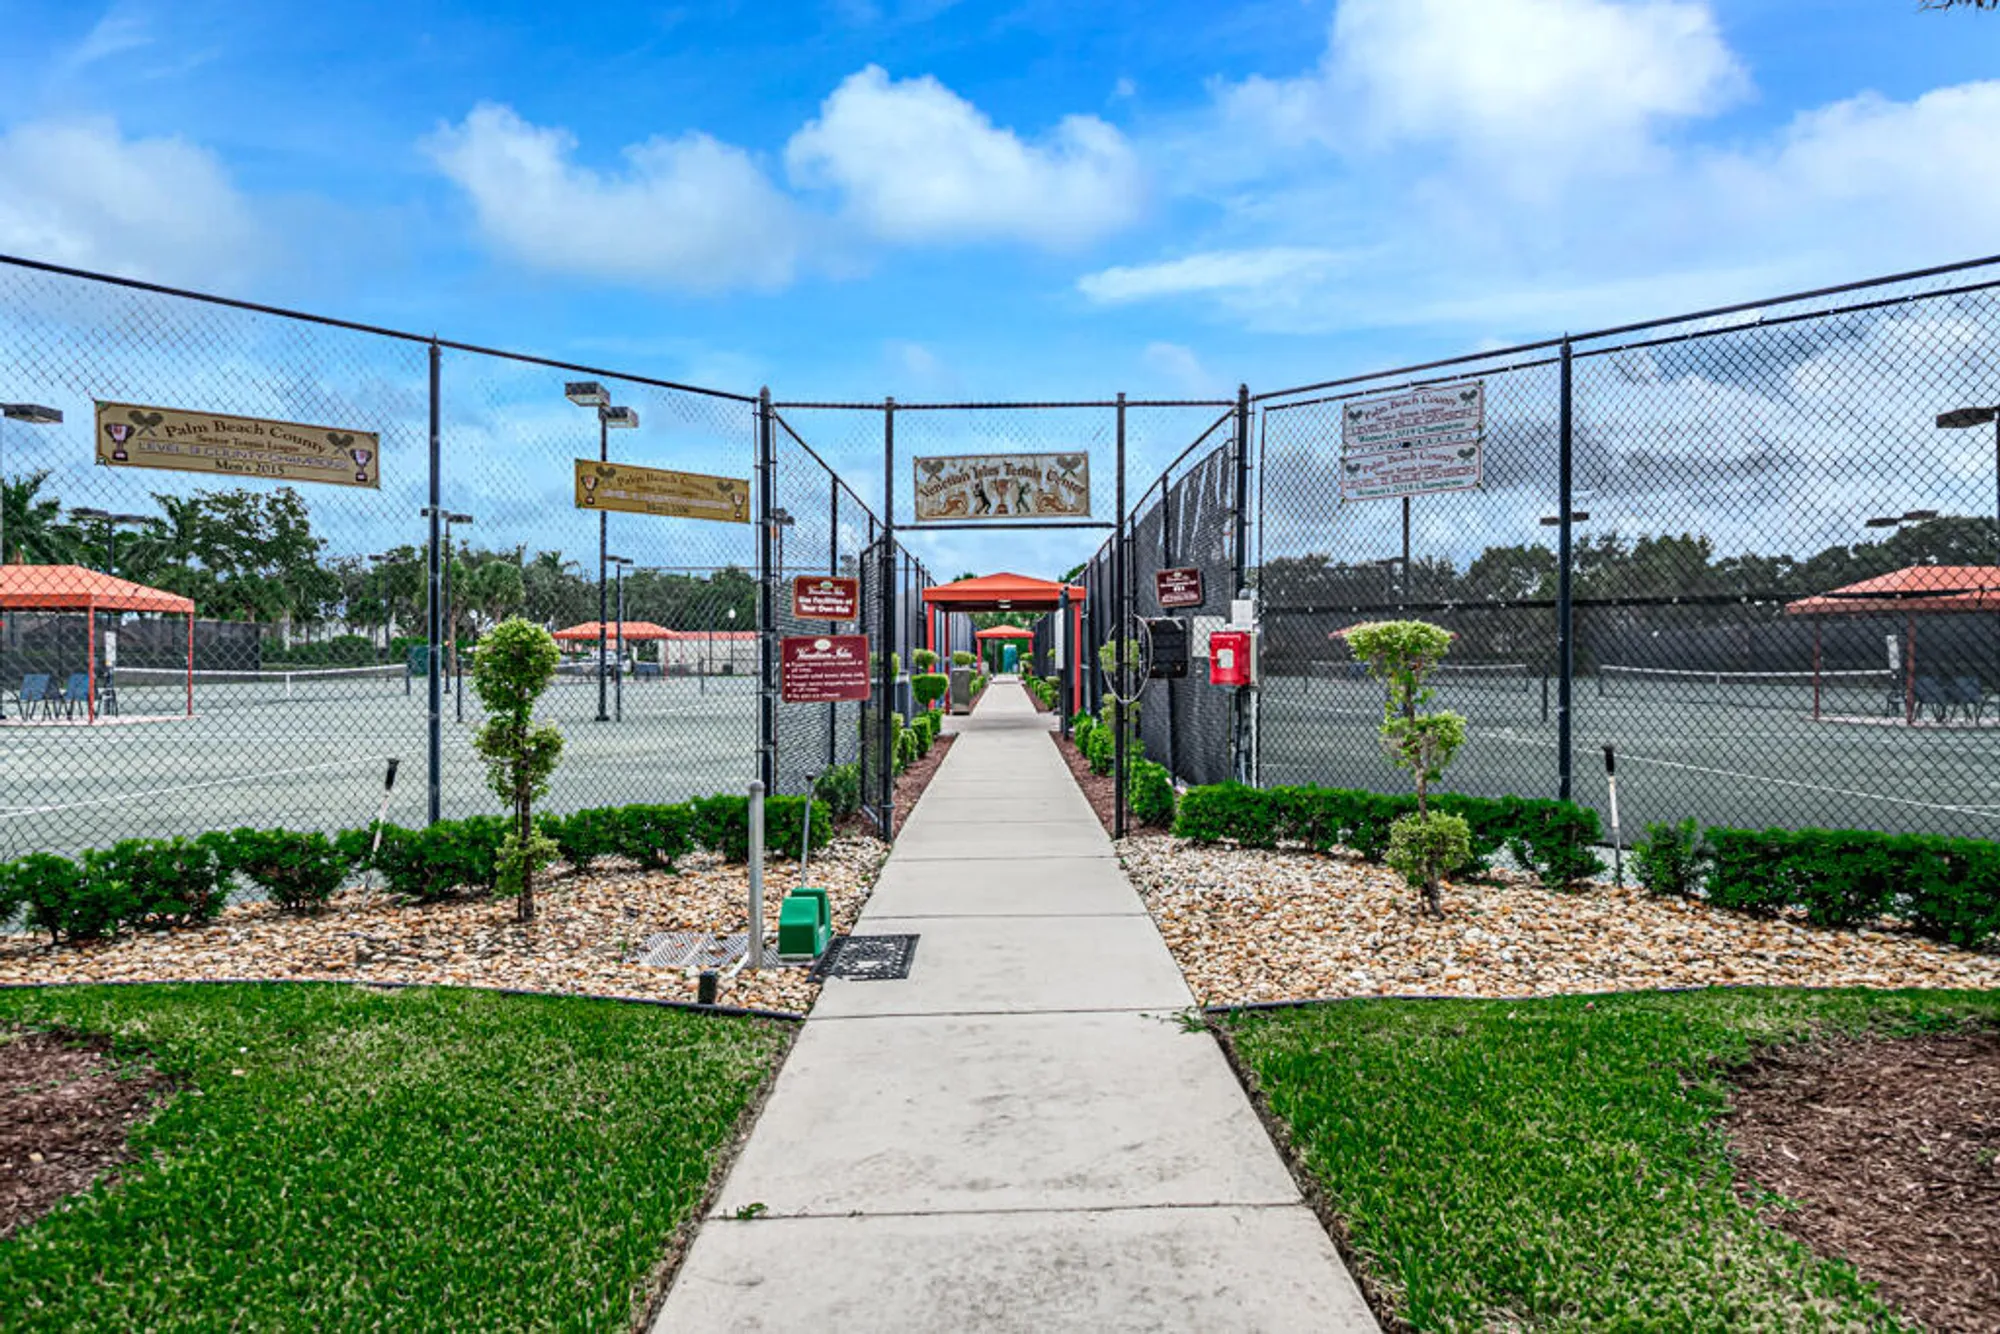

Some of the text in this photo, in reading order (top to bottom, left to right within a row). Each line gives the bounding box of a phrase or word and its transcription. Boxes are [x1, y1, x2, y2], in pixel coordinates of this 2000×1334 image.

[1390, 396, 1419, 409] Beach
[164, 419, 327, 454] Palm Beach County
[215, 459, 286, 475] Men's 2015
[919, 461, 1087, 498] Venetian Isles Tennis Center
